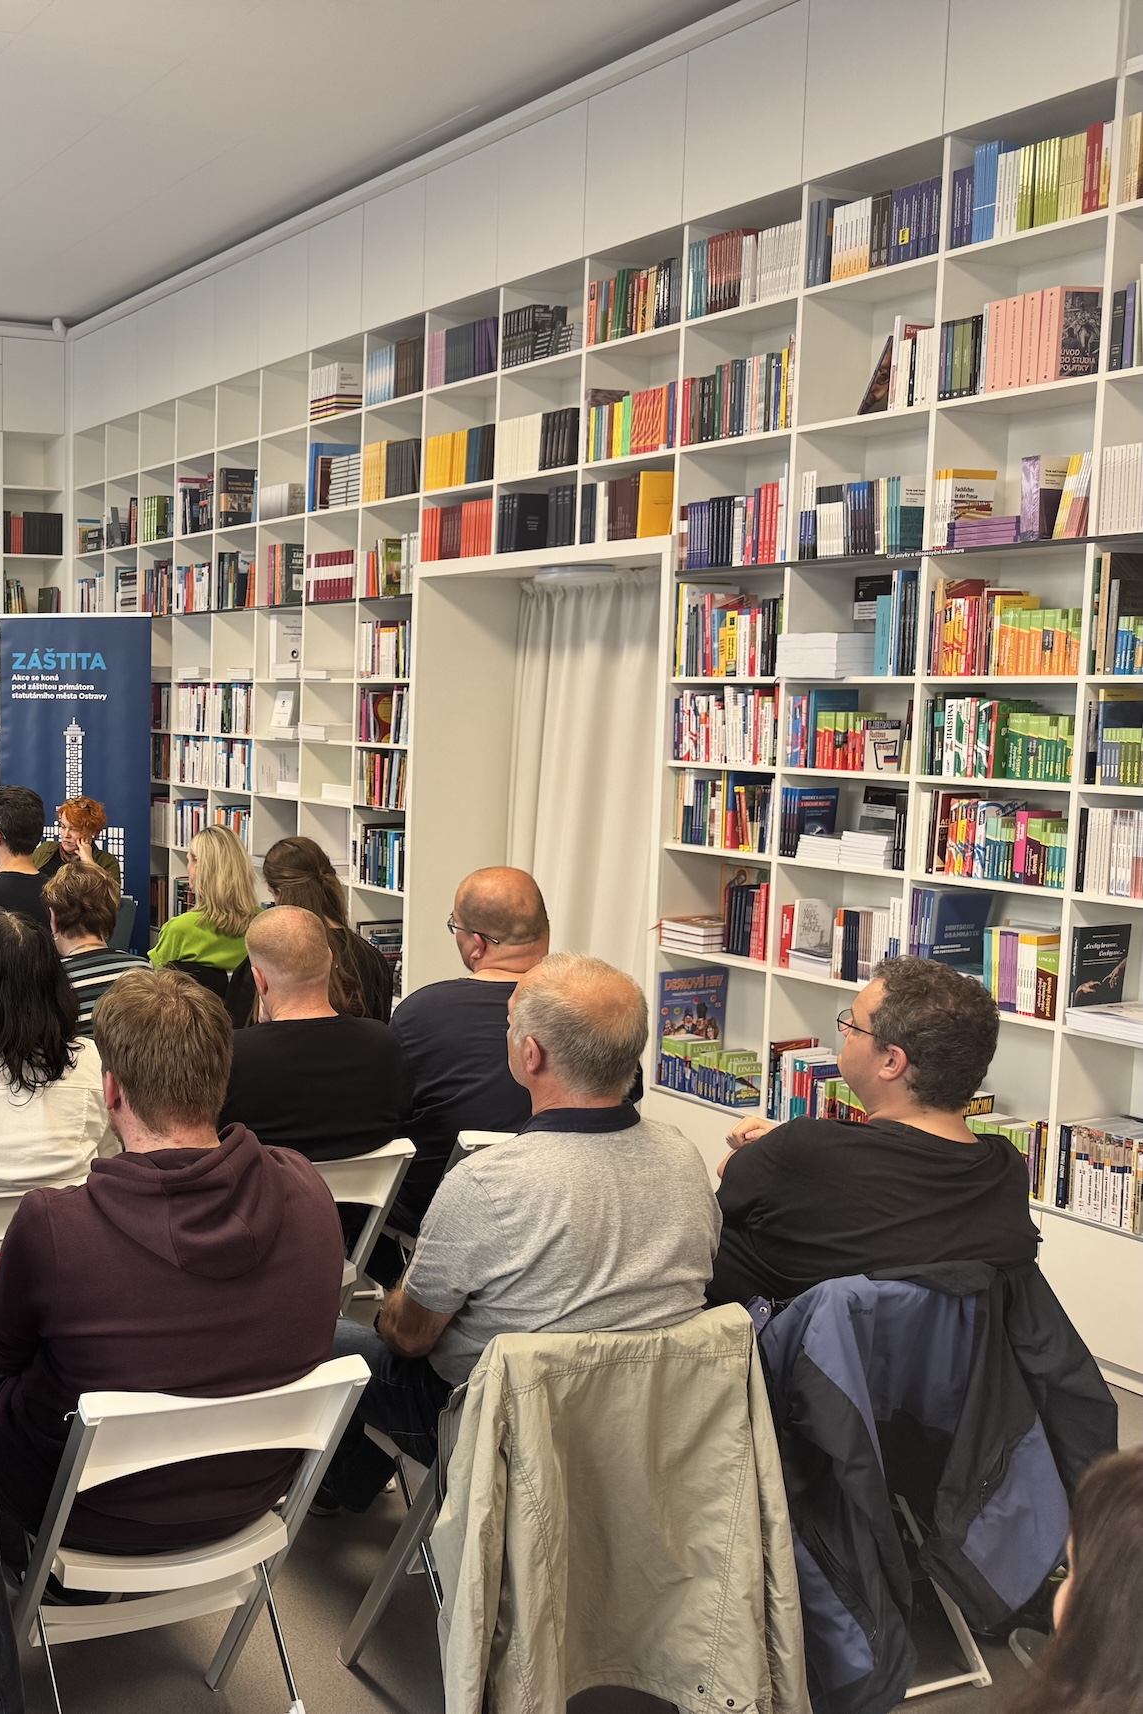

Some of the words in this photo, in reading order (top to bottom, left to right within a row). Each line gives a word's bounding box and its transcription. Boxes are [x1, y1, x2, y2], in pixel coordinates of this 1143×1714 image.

[1060, 356, 1070, 364] DO
[1060, 364, 1089, 372] POLITIKY
[12, 648, 107, 670] ZÁŠTITA
[12, 683, 26, 691] pod
[59, 683, 94, 691] primátora
[78, 693, 107, 701] Ostravy
[946, 704, 954, 739] ITALŠTINA
